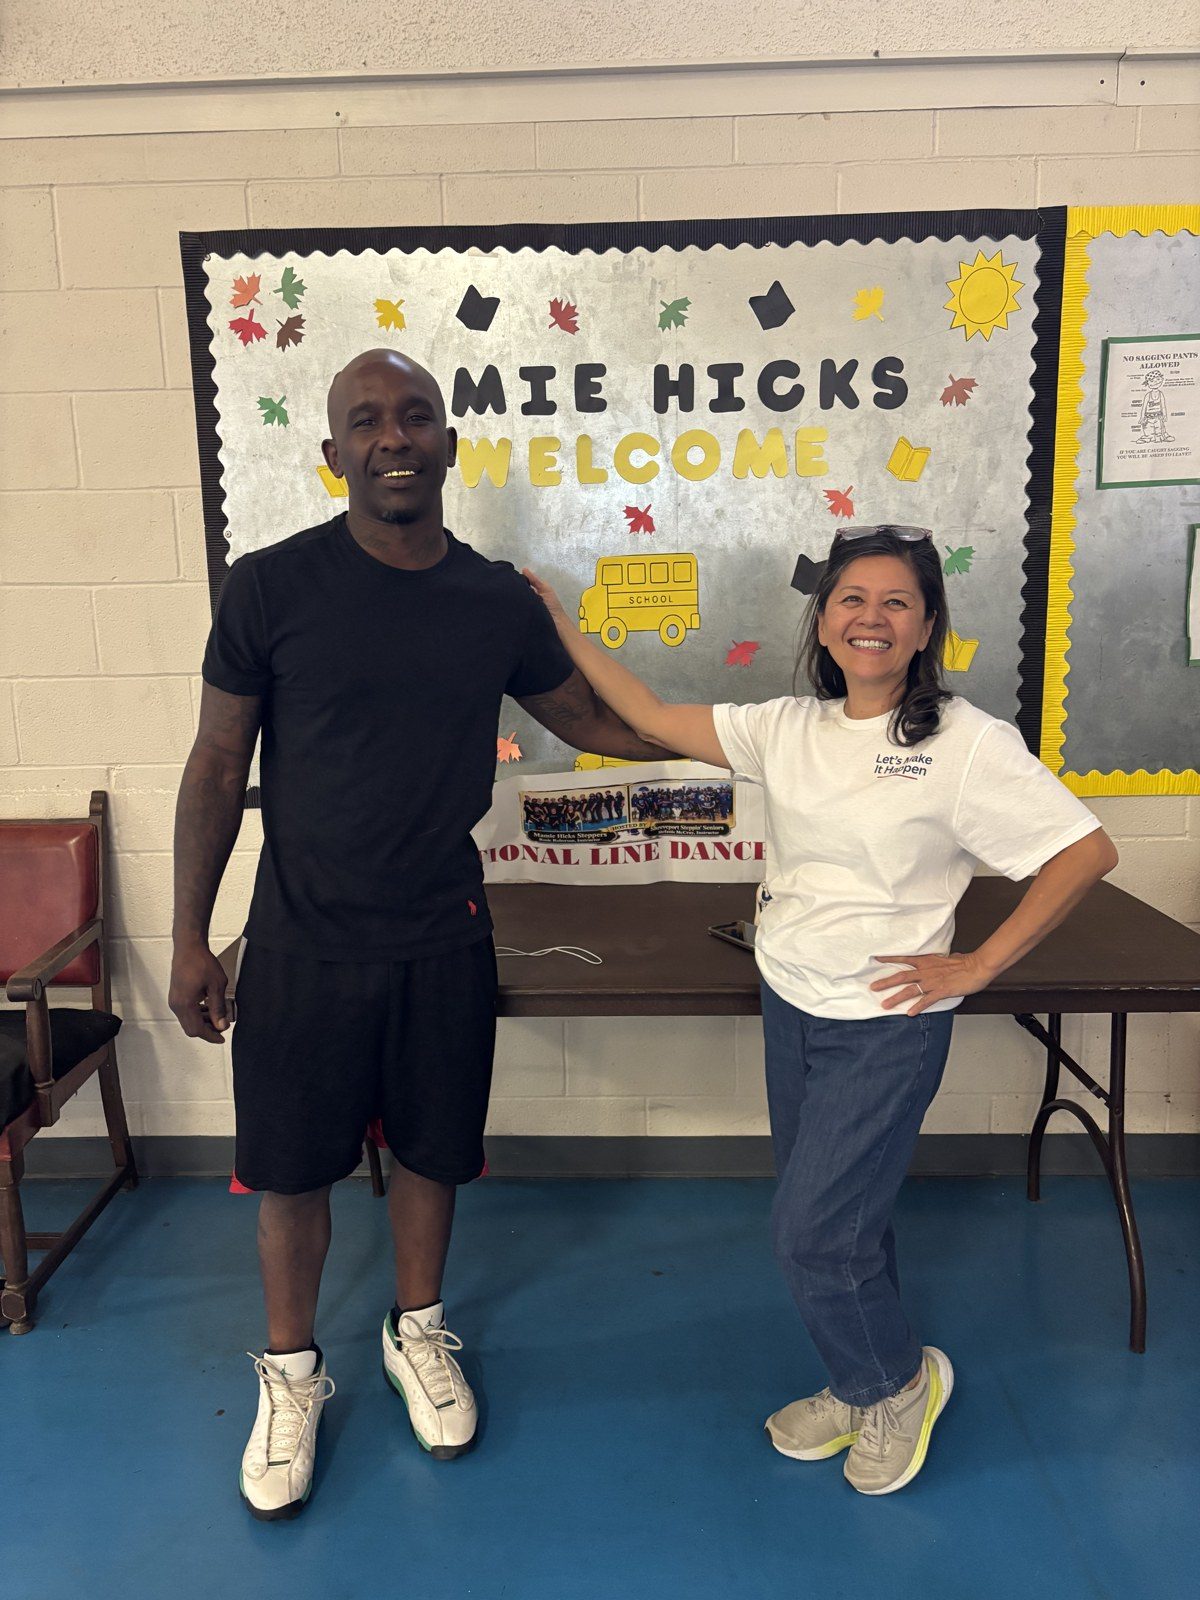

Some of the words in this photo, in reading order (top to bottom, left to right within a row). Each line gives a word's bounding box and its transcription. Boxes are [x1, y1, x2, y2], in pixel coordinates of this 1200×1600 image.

[1139, 361, 1180, 369] ALLOWED
[653, 356, 908, 414] HICKS
[456, 427, 830, 489] WELCOME
[629, 596, 673, 604] SCHOOL
[903, 753, 933, 765] Make
[874, 765, 883, 774] It
[883, 765, 927, 776] Happen
[589, 841, 660, 865] LINE
